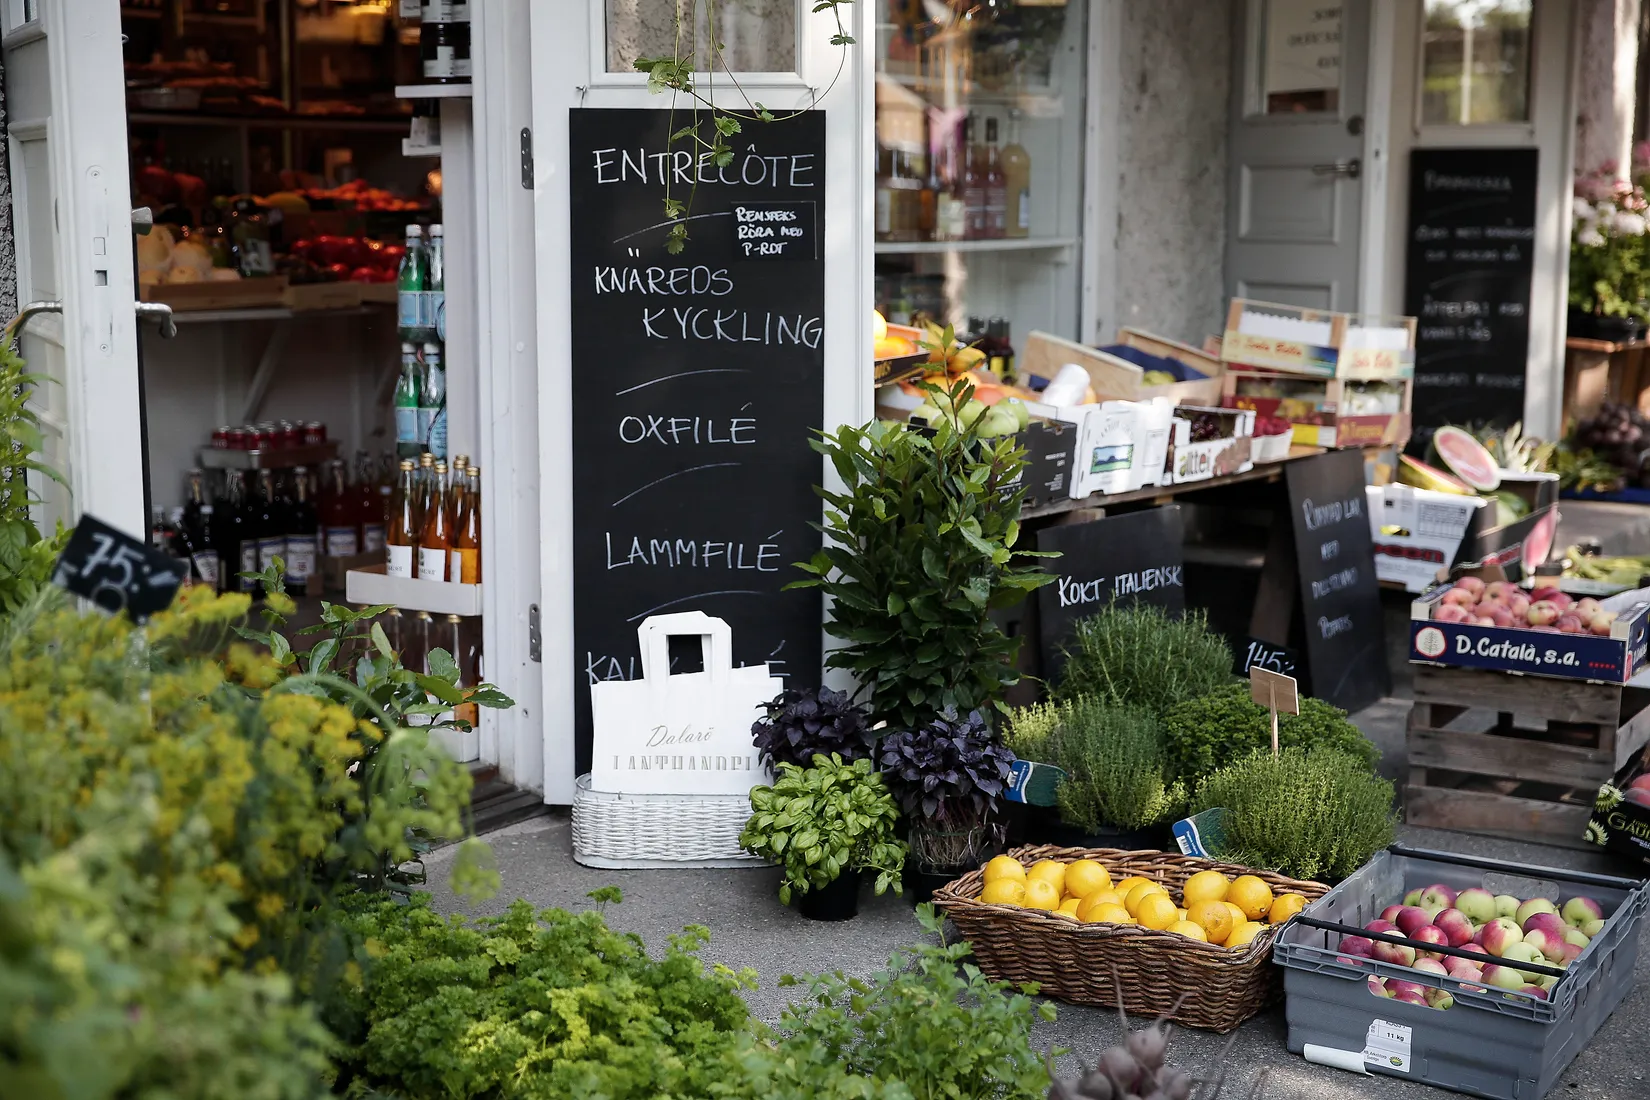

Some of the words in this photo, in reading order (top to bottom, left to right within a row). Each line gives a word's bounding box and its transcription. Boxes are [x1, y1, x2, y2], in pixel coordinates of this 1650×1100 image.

[592, 143, 815, 188] ENTRECÔTE
[737, 223, 775, 240] RÖRA
[594, 247, 734, 296] KNÄREDS
[642, 306, 823, 349] KYCKLING
[618, 401, 757, 445] OXFILÉ
[605, 529, 782, 573] LAMMFILÉ
[1058, 575, 1105, 608] KOKT
[1115, 565, 1183, 598] ITALIENSK
[645, 723, 715, 749] Dalarö
